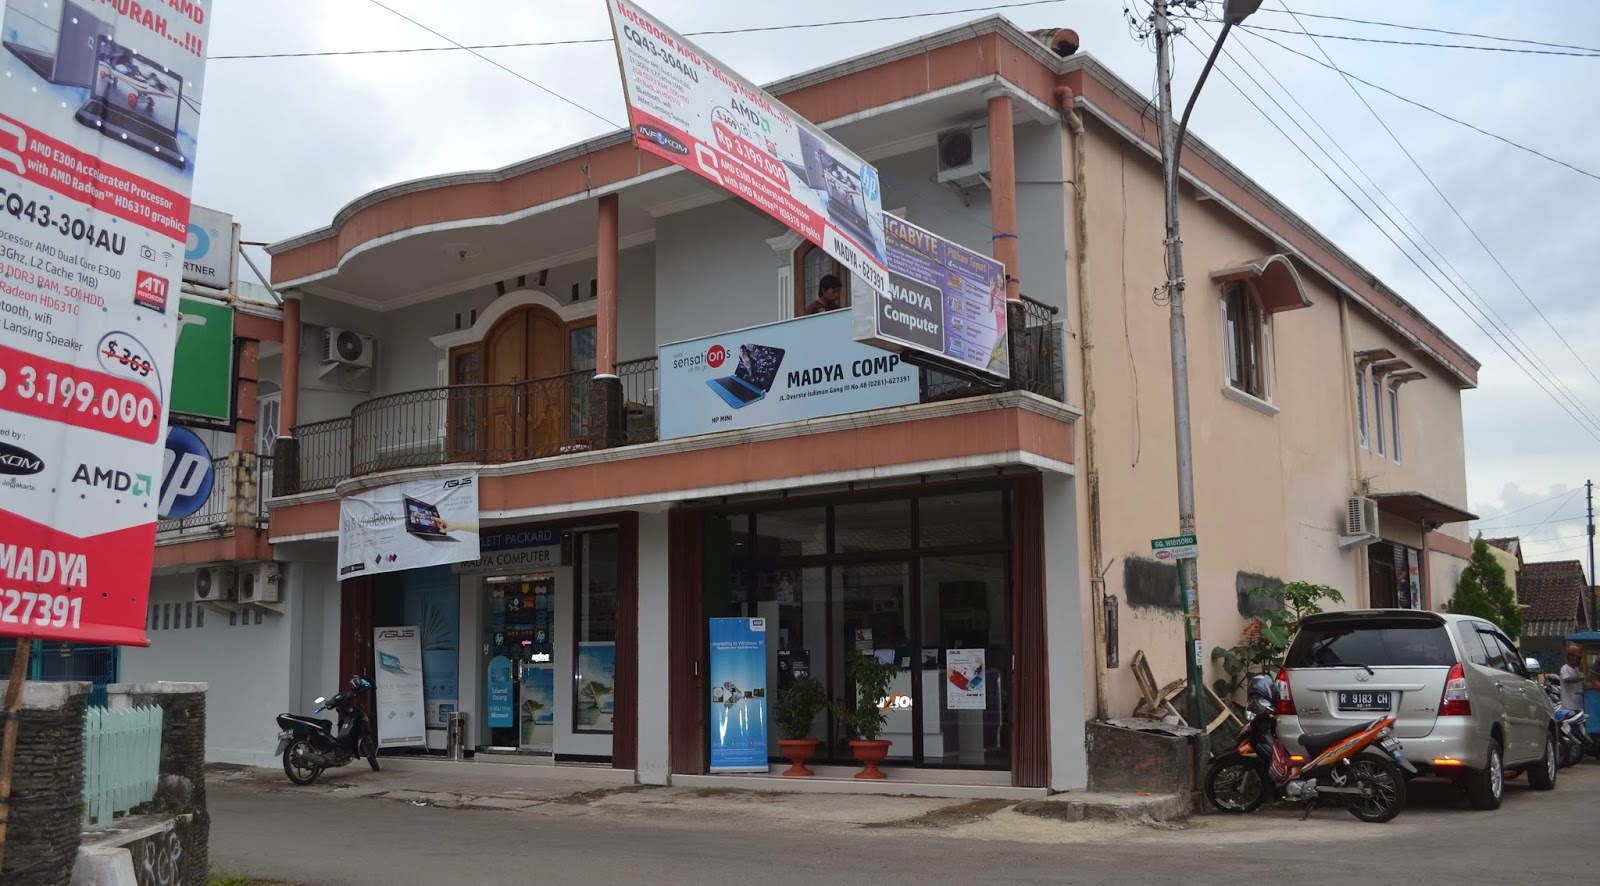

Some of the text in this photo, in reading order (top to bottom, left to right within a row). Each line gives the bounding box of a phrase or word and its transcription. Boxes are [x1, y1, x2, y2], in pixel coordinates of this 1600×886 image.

[624, 25, 698, 83] CQ43-304AU
[732, 98, 760, 126] AMD
[716, 126, 733, 152] Rp
[735, 139, 786, 183] 3.199.000
[721, 159, 735, 174] AMD
[30, 139, 173, 210] AMD E300 Accelerated Processor
[28, 159, 49, 176] with
[51, 168, 71, 186] AMD
[115, 194, 150, 217] HD6310
[151, 211, 186, 233] graphics
[724, 175, 738, 189] with
[739, 182, 752, 198] AMD
[800, 222, 820, 242] graphics
[30, 256, 43, 269] L2
[46, 262, 74, 280] Cache
[78, 272, 98, 290] 1MB)
[36, 242, 56, 257] AMD
[58, 250, 78, 264] Dual
[80, 258, 96, 272] Core
[99, 263, 121, 280] E300
[834, 237, 858, 270] MADYA
[862, 262, 884, 291] 627391
[0, 281, 80, 316] Radeon HD6310
[7, 266, 34, 284] DDR3
[84, 293, 104, 308] HDD
[890, 286, 932, 312] MADYA
[0, 300, 52, 325] tooth, wifi
[884, 304, 938, 334] Computer
[4, 318, 83, 352] Lansing Speaker
[120, 348, 150, 377] 369
[788, 354, 899, 388] MADYA COMP
[18, 366, 154, 428] 3.199.000
[830, 386, 843, 394] Gang
[12, 430, 21, 440] by
[72, 464, 132, 492] AMD
[442, 477, 472, 489] ASUS
[505, 530, 552, 545] PACKARD
[0, 544, 88, 588] MADYA
[496, 550, 550, 564] COMPUTER
[0, 588, 83, 629] 27391
[378, 630, 414, 638] ASUS
[1341, 694, 1388, 704] R 9183 CH
